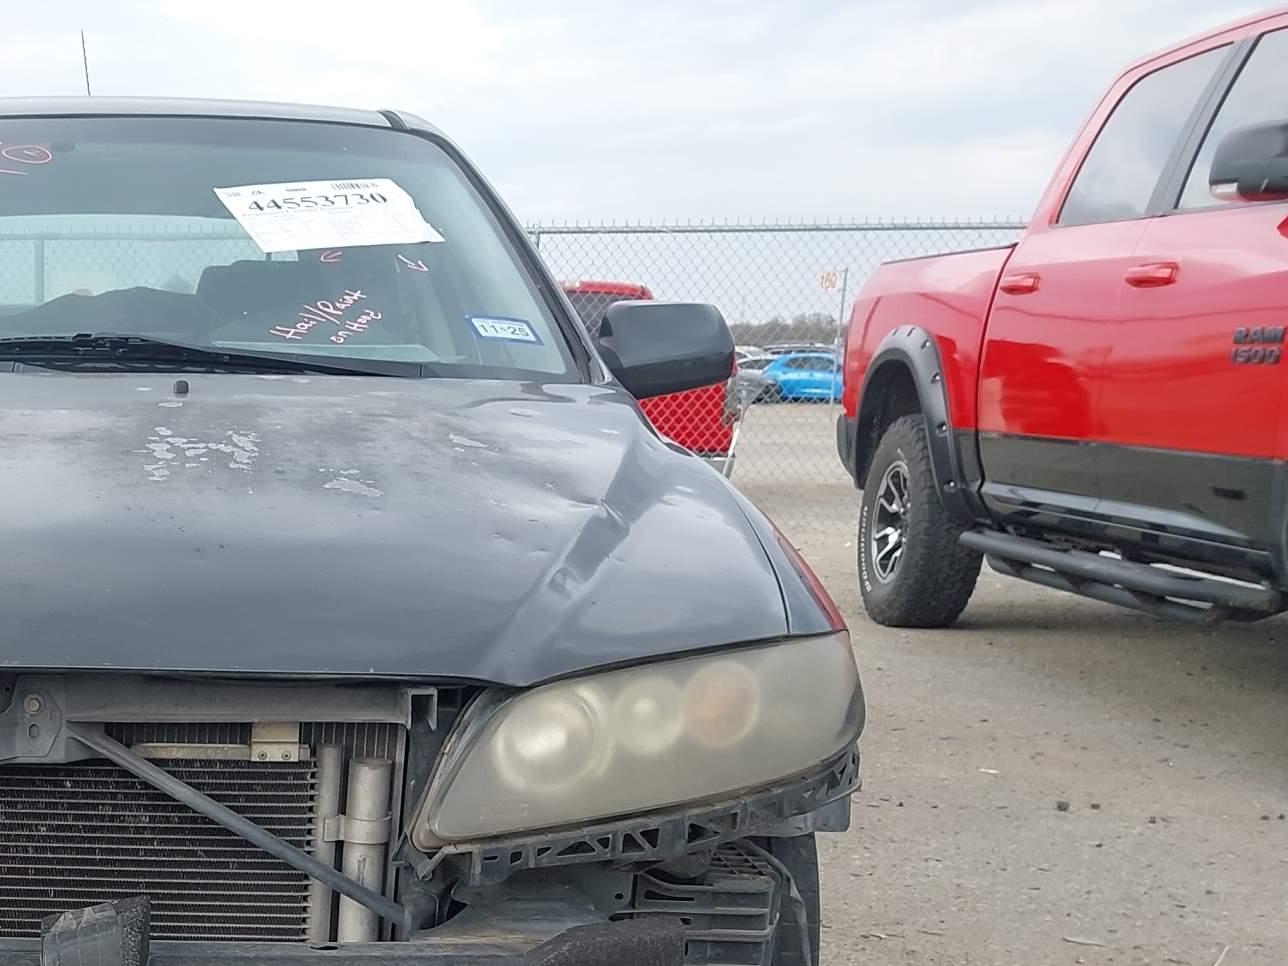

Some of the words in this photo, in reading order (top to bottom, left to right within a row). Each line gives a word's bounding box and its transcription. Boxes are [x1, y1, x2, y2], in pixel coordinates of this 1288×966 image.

[247, 191, 389, 213] 44553730
[1233, 327, 1285, 344] RAM
[1232, 346, 1280, 365] 1500
